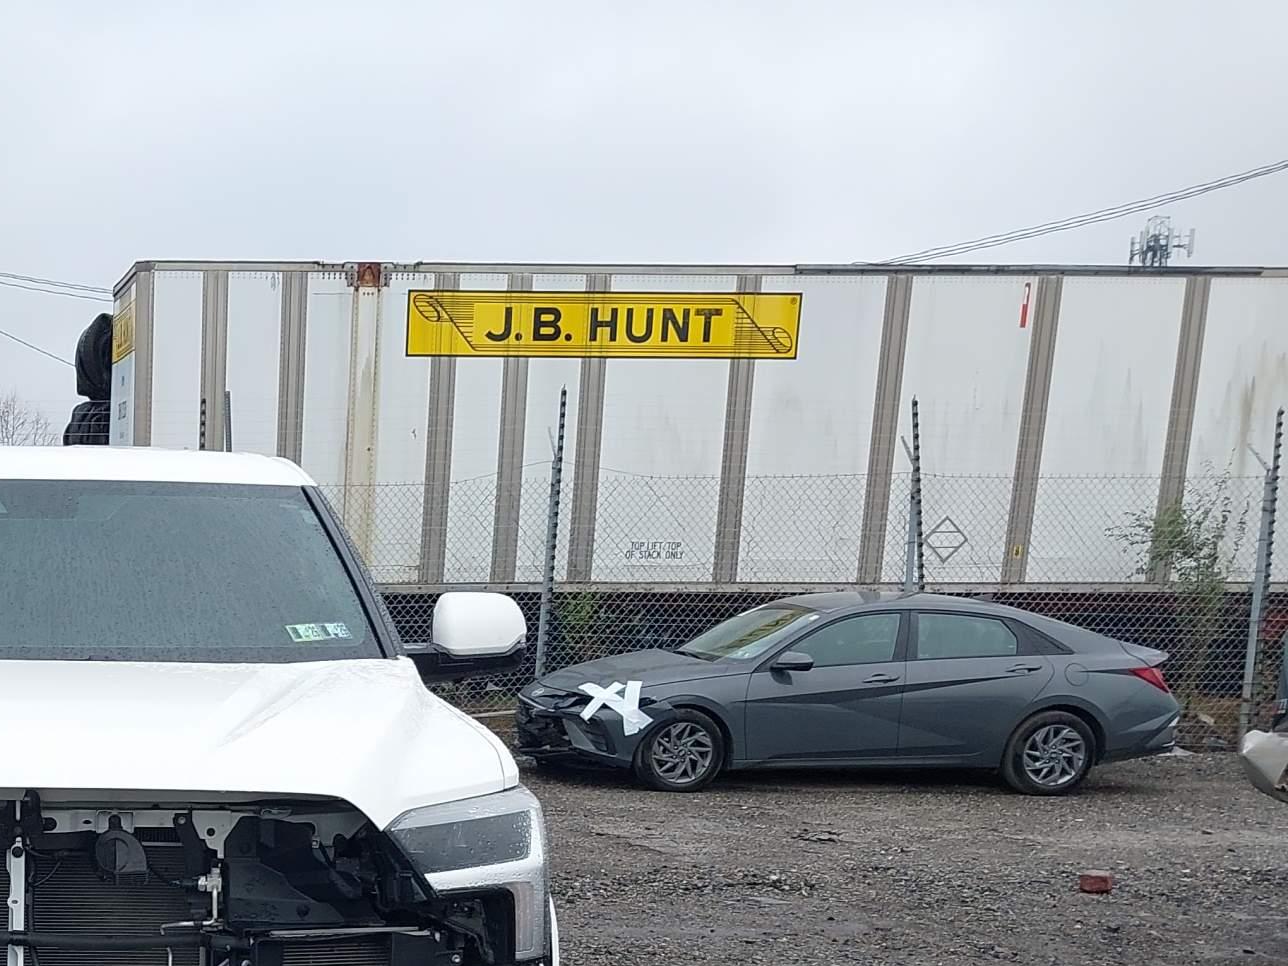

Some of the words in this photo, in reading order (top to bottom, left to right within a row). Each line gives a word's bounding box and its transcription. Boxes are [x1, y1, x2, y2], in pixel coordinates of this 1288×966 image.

[486, 307, 571, 341] J.B.
[590, 308, 721, 343] HUNT
[631, 541, 645, 550] TOP
[625, 551, 635, 559] OF
[639, 551, 661, 559] STACK
[665, 551, 684, 559] ONLY
